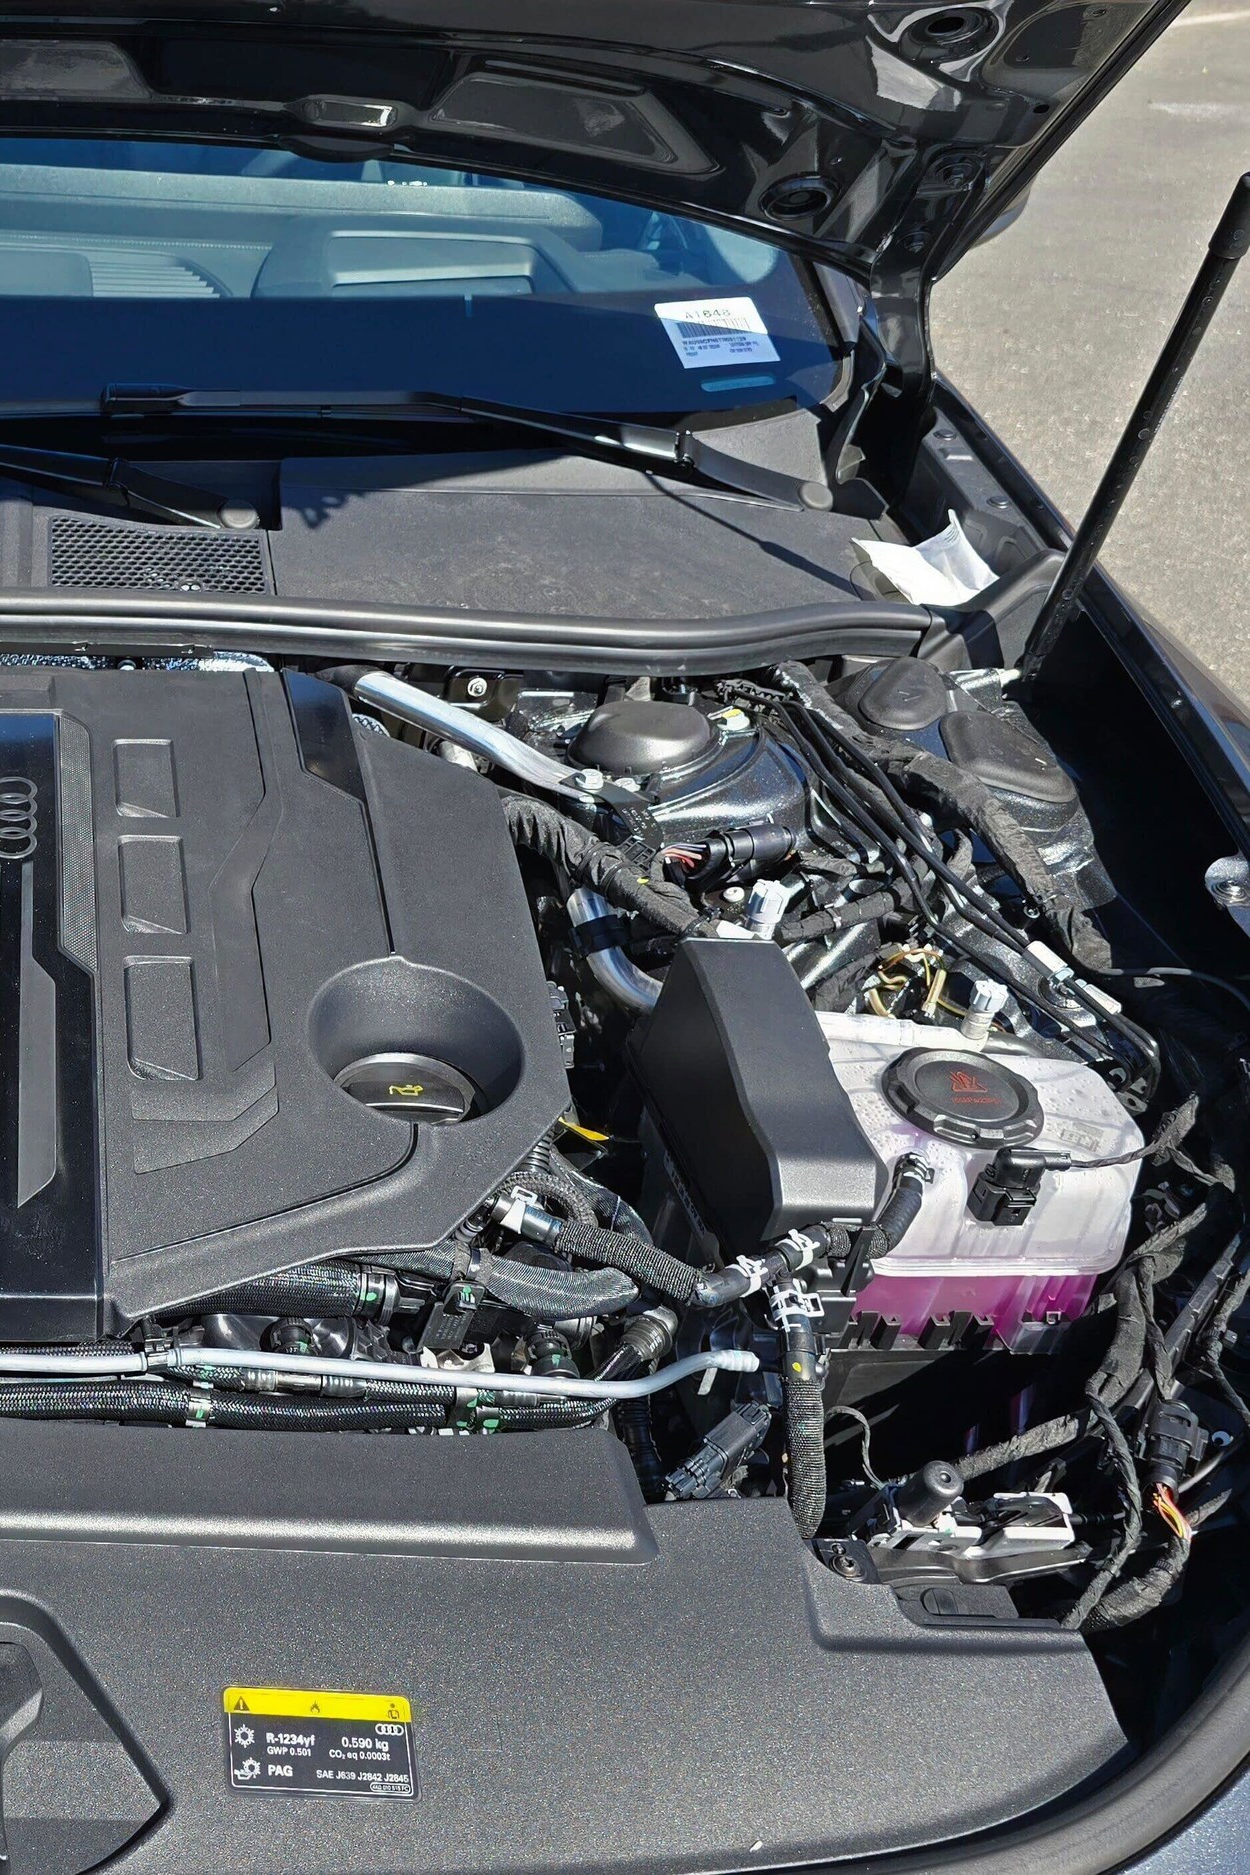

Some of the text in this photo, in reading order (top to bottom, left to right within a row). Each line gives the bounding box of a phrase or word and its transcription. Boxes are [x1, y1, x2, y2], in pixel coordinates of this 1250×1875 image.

[266, 1732, 390, 1752] R-1234yf 0.590 kg
[266, 1746, 288, 1755] GWP
[290, 1747, 312, 1756] 0.501
[347, 1752, 358, 1760] eq
[359, 1751, 391, 1761] 0.0003t
[268, 1764, 294, 1777] PAG
[316, 1770, 410, 1783] SAE J639 J2842 J2845
